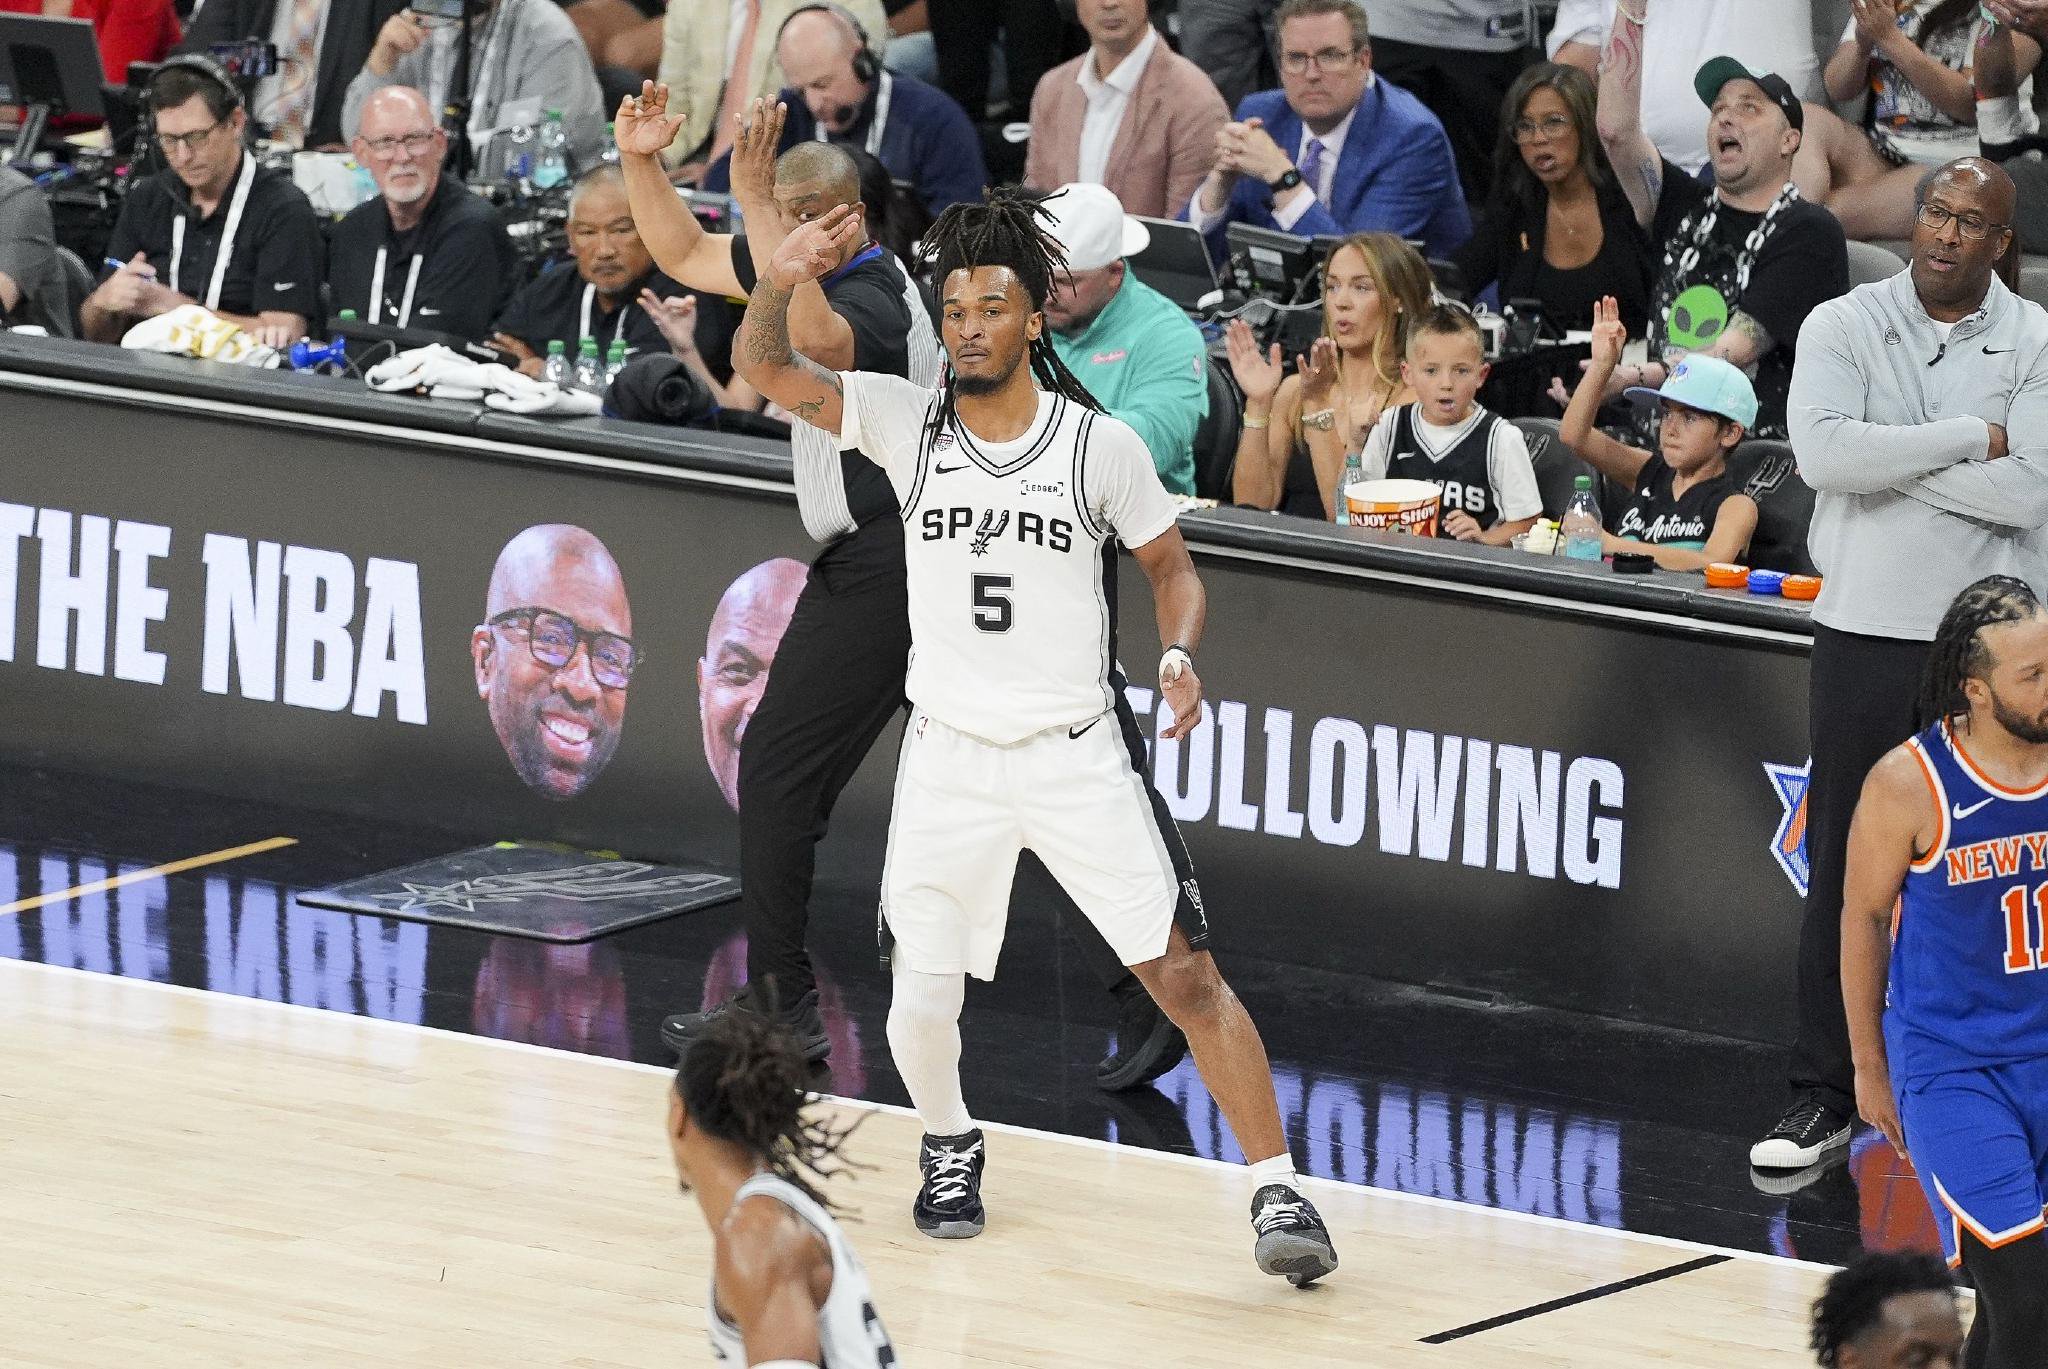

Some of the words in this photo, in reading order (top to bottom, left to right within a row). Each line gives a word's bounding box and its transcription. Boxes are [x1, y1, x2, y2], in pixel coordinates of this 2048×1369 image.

[1024, 483, 1059, 494] LEDGER
[923, 507, 1073, 557] SPURS
[1645, 513, 1706, 543] Antonio
[0, 503, 172, 685] THE
[202, 533, 428, 725] NBA
[971, 573, 1014, 634] 5
[1945, 835, 2022, 886] NEW
[2025, 831, 2048, 871] Y
